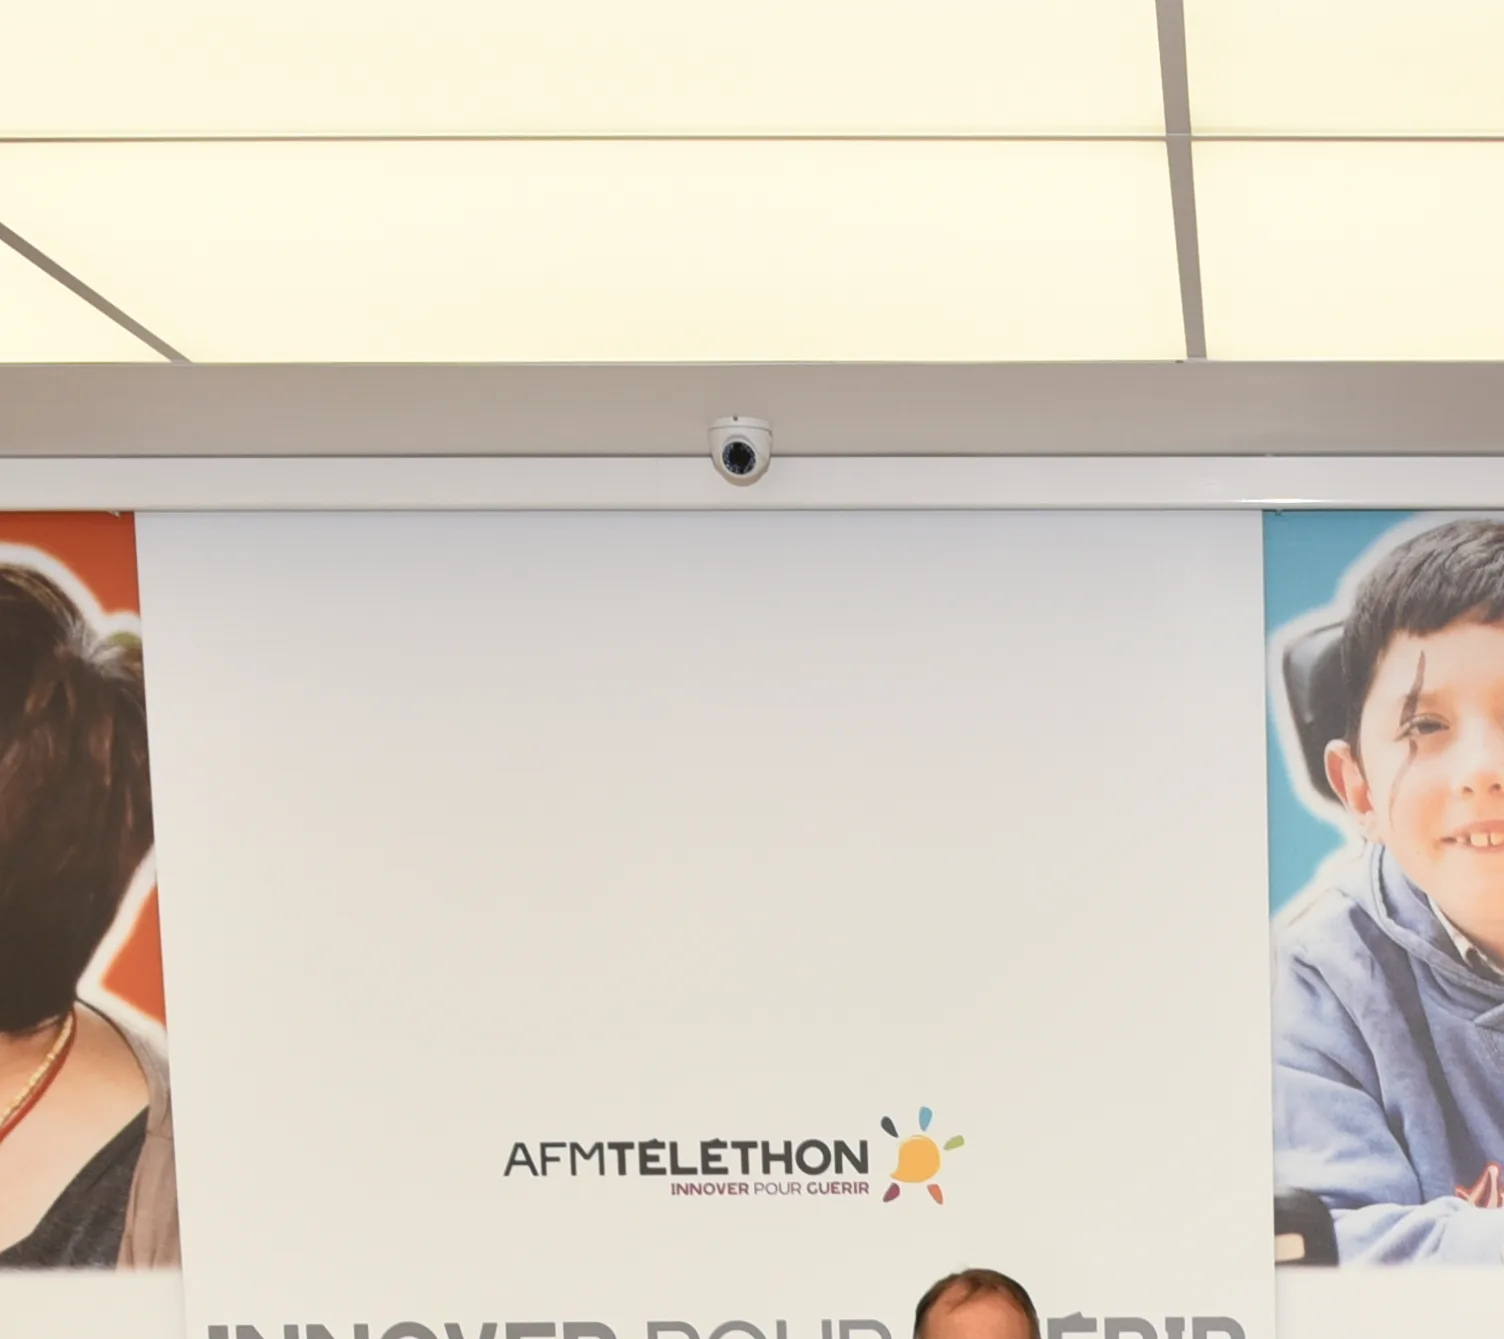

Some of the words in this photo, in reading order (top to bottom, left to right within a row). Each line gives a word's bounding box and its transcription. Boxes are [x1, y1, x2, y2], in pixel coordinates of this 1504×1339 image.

[503, 1137, 869, 1177] AFMTÉLÉTHON
[670, 1182, 749, 1196] INNOVER
[754, 1182, 802, 1196] POUR
